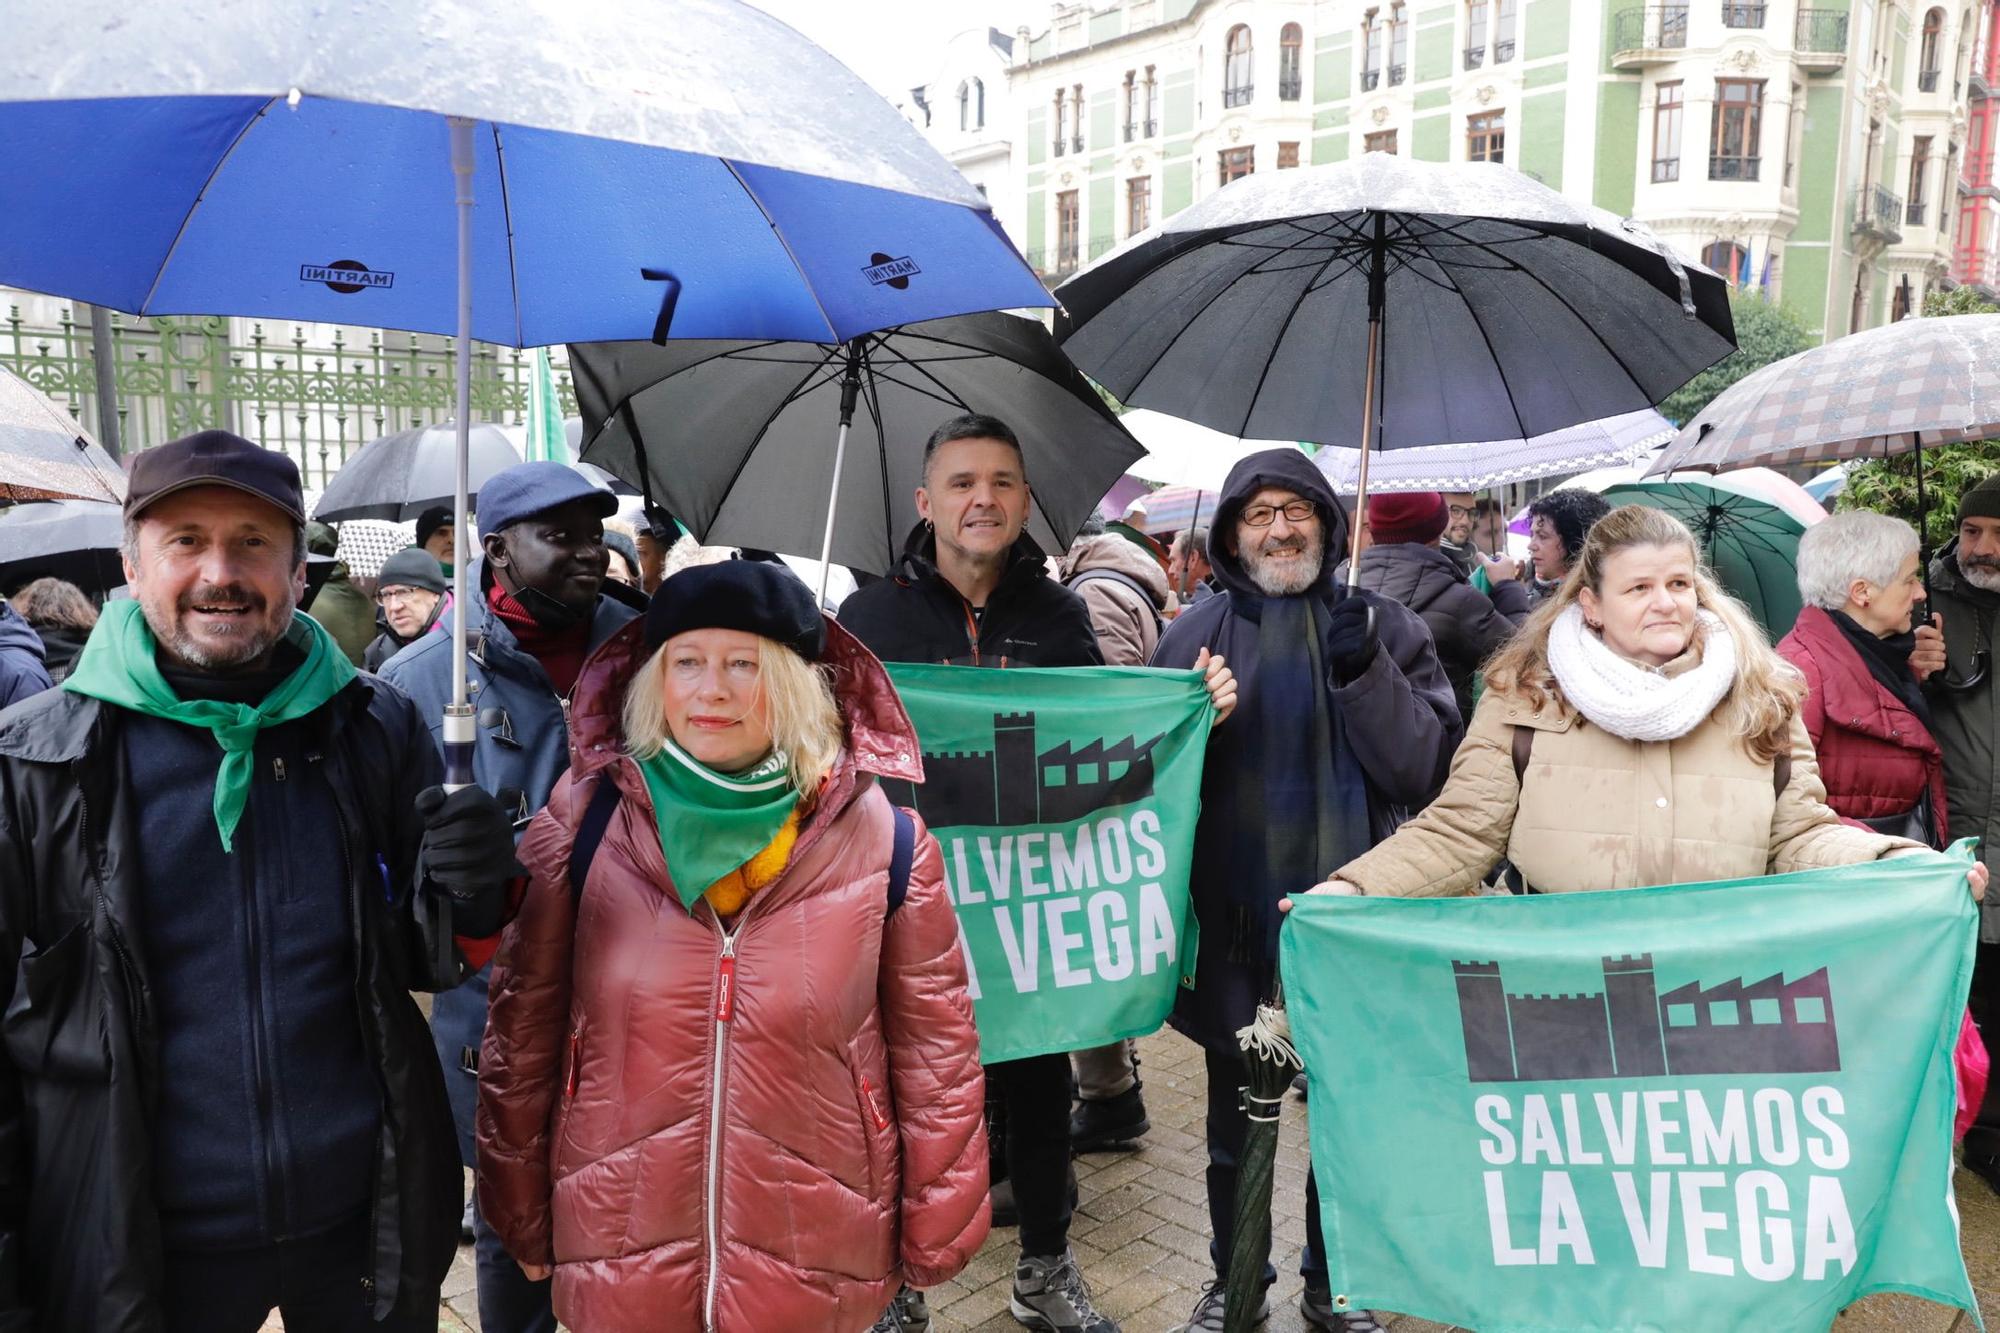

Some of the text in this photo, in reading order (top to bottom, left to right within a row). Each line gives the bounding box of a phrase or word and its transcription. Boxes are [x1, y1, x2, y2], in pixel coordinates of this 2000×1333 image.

[938, 809, 1166, 906] LVEMOS
[993, 882, 1176, 993] VEGA
[1474, 1085, 1851, 1170] SALVEMOS
[1483, 1170, 1858, 1282] LA VEGA
